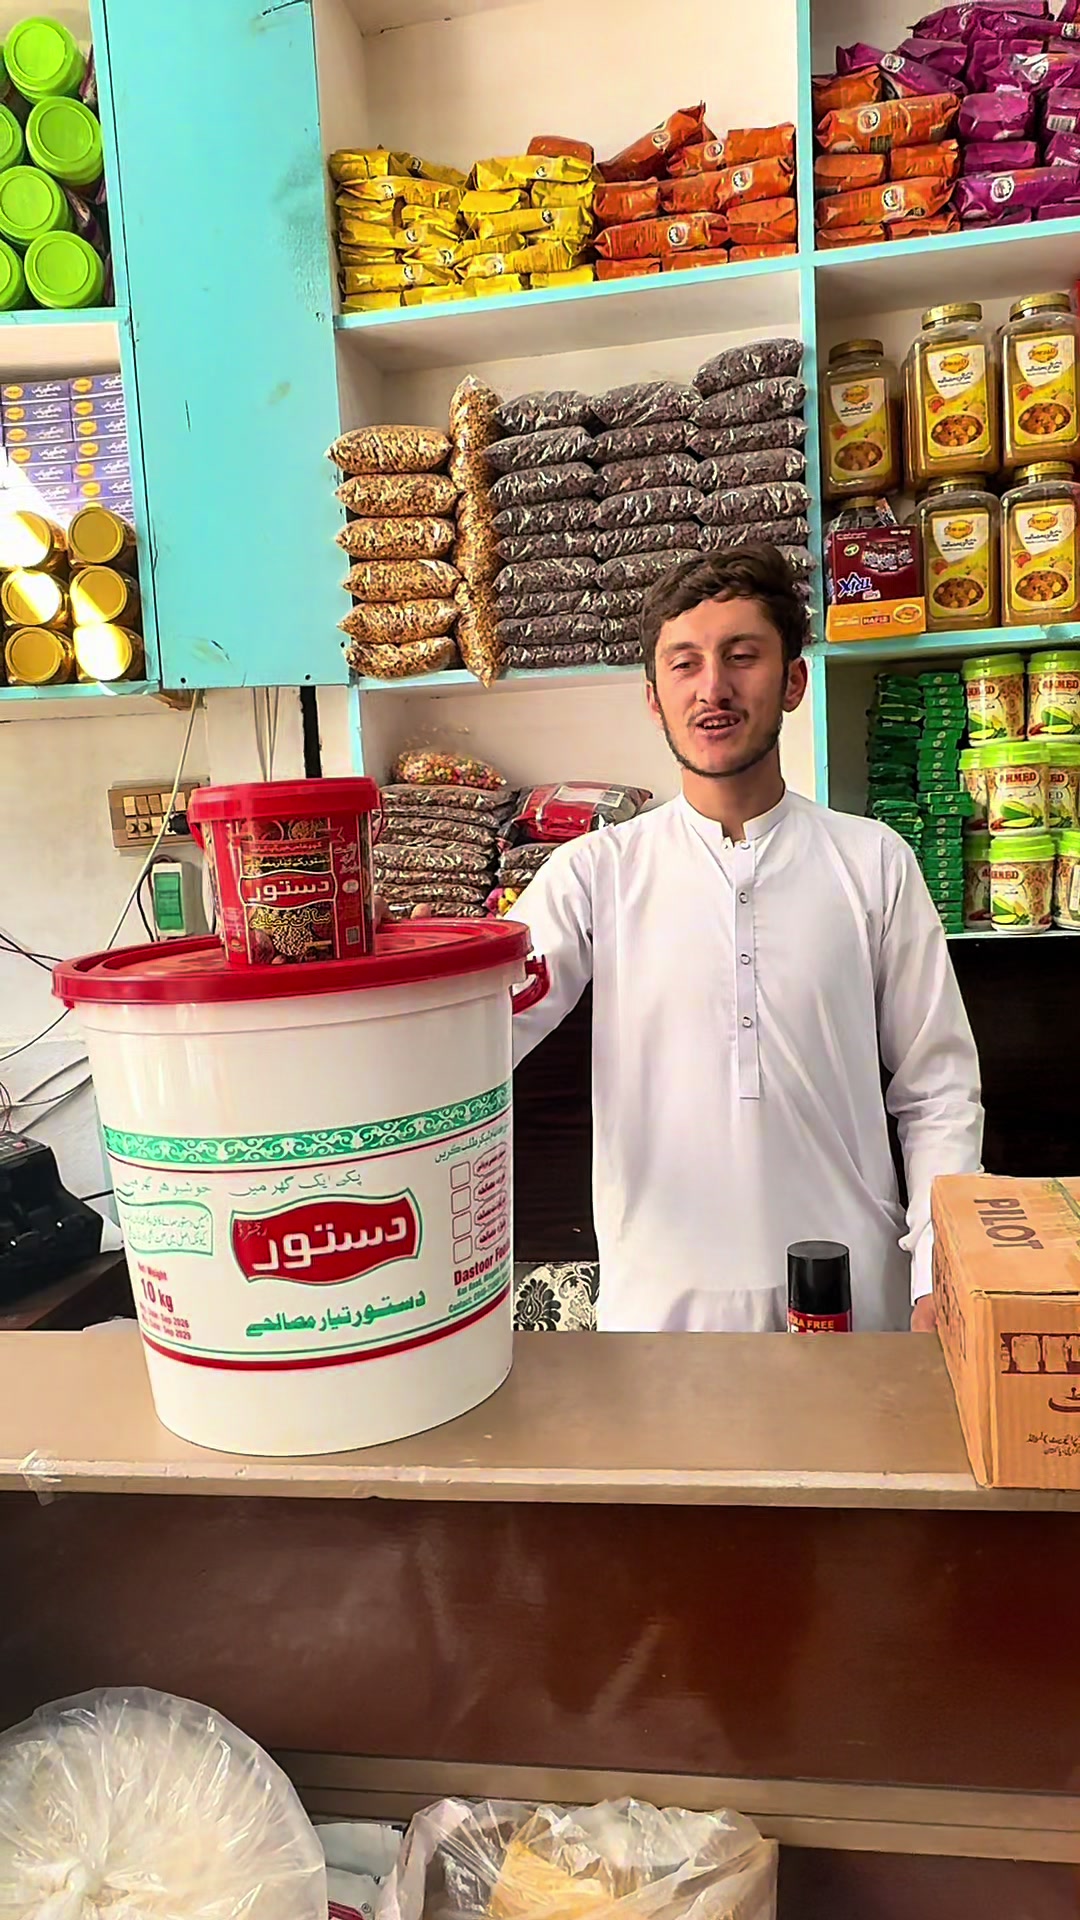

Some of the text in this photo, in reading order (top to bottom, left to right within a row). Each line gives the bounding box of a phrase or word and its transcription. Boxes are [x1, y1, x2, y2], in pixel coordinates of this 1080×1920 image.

[247, 880, 329, 902] دستور
[973, 1198, 1045, 1250] PILOT
[252, 1215, 407, 1271] دستور
[454, 1255, 493, 1286] Dastoor
[141, 1278, 174, 1313] 10 kg
[245, 1290, 426, 1337] دستور تیار مصالحے
[807, 1319, 835, 1329] FREE
